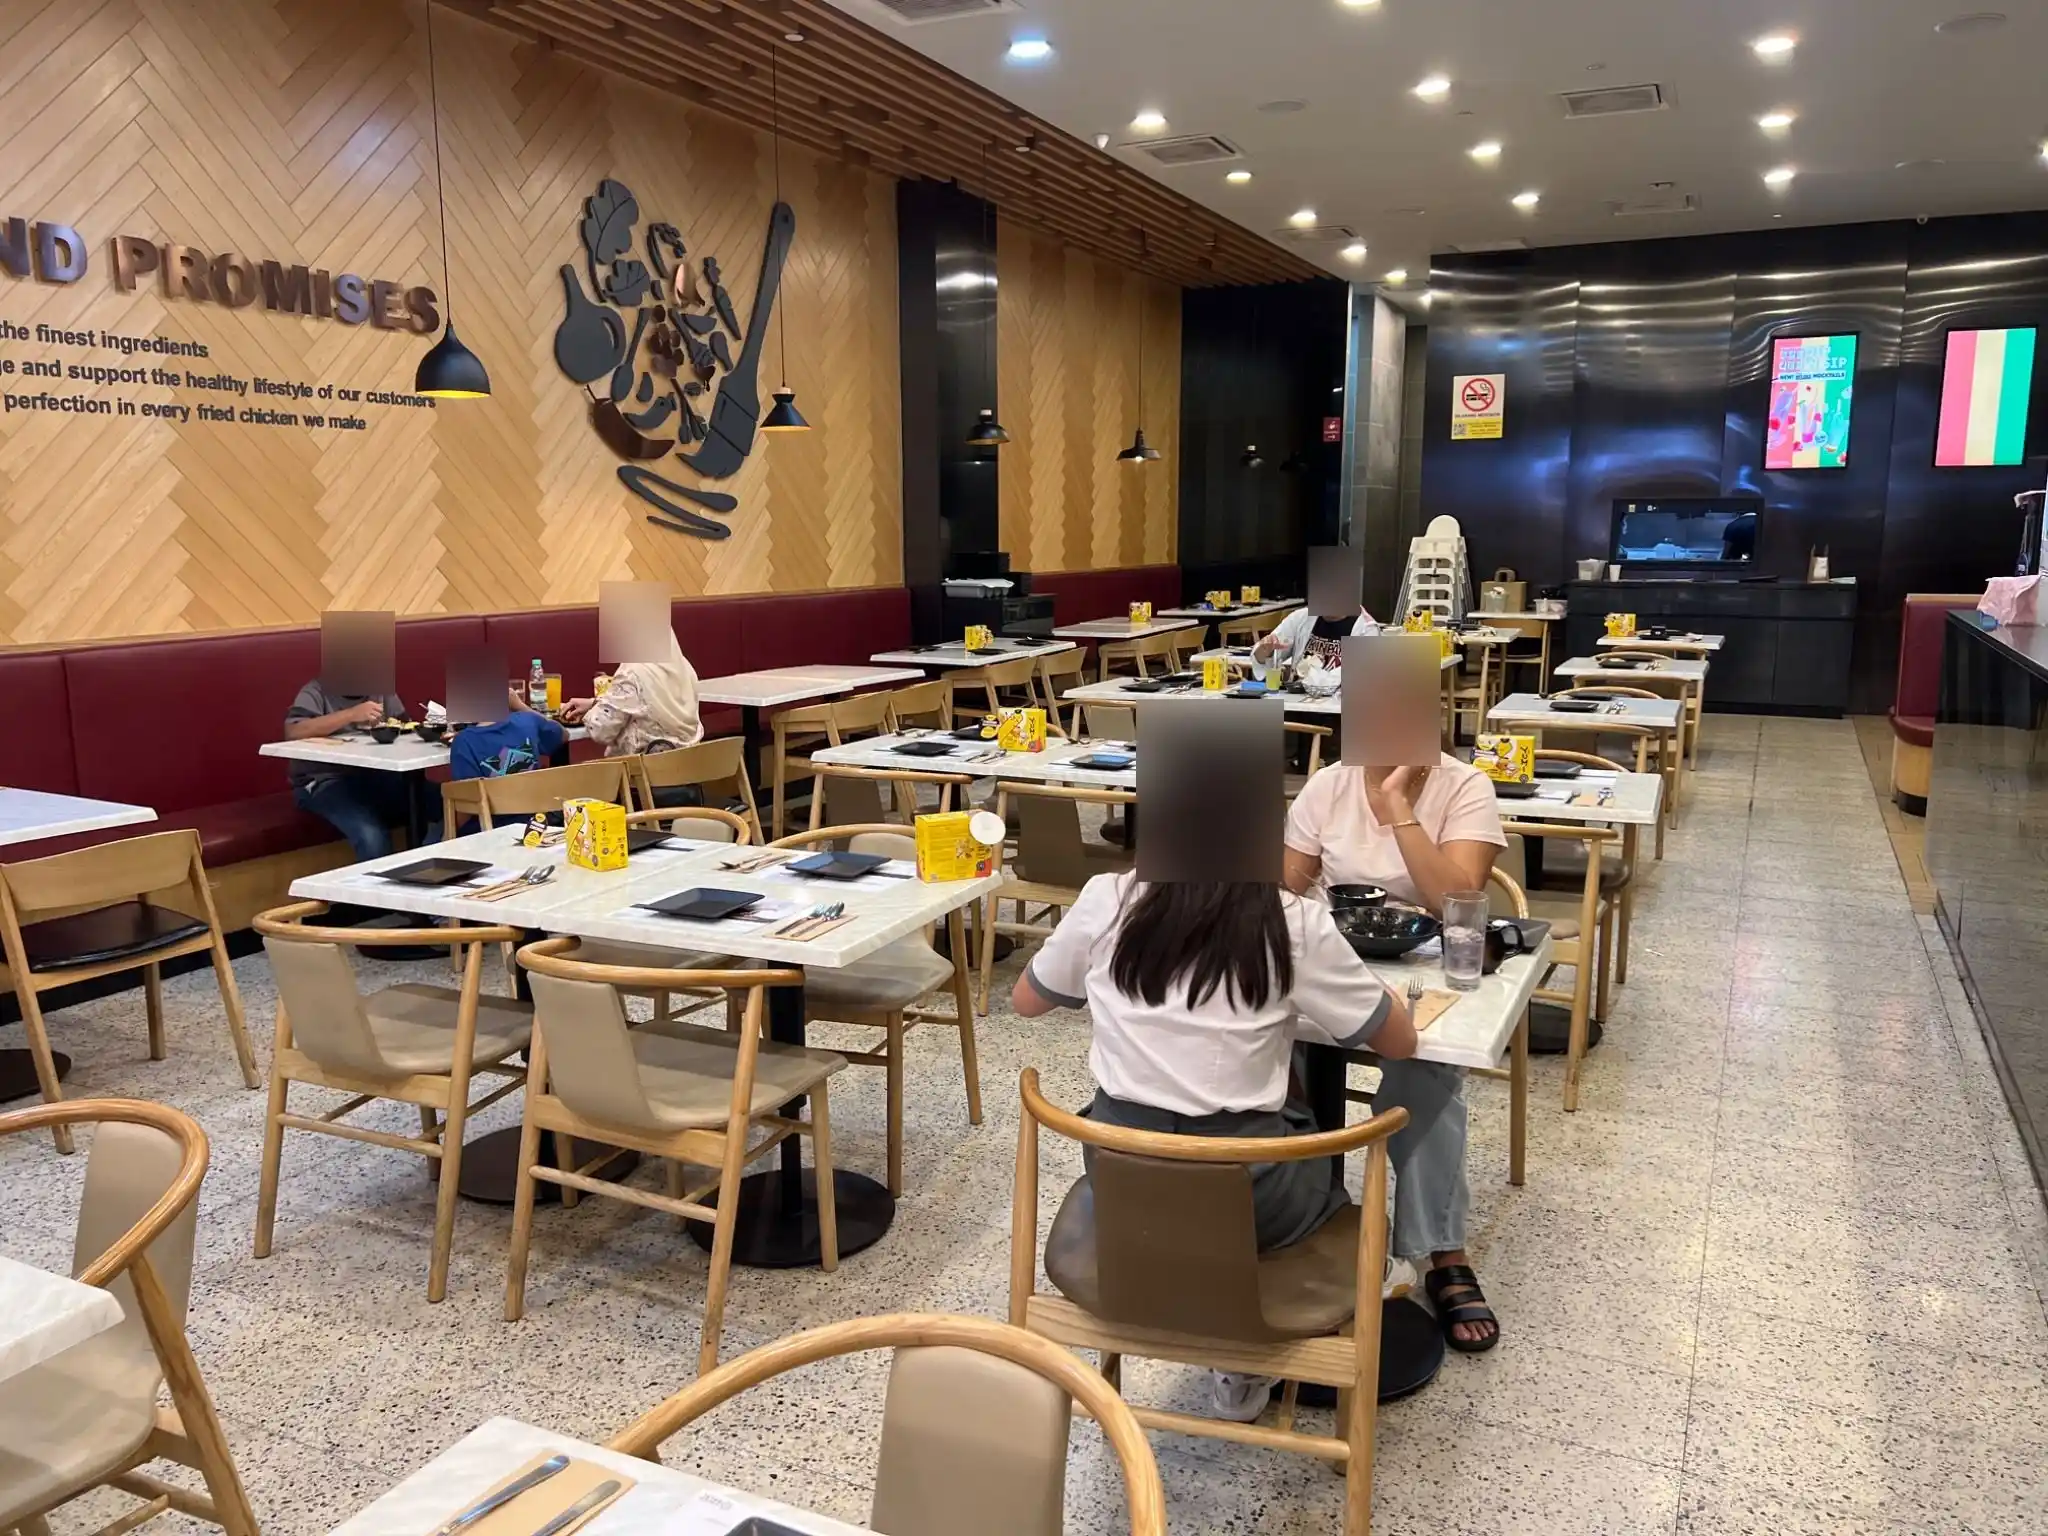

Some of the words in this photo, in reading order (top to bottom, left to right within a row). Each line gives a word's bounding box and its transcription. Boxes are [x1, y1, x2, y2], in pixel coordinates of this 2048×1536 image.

[110, 235, 440, 333] PROMISES
[36, 324, 96, 347] finest
[101, 331, 209, 358] ingredients
[22, 359, 62, 377] and
[68, 364, 148, 385] support
[151, 368, 181, 386] the
[186, 371, 248, 396] healthy
[254, 377, 313, 400] lifestyle
[318, 384, 334, 399] of
[338, 387, 361, 402] our
[366, 389, 436, 409] customers
[4, 392, 111, 414] perfection
[117, 397, 136, 416] in
[141, 403, 191, 423] every
[197, 403, 235, 422] fried
[240, 407, 298, 426] chicken
[303, 414, 325, 428] we
[329, 415, 366, 430] make
